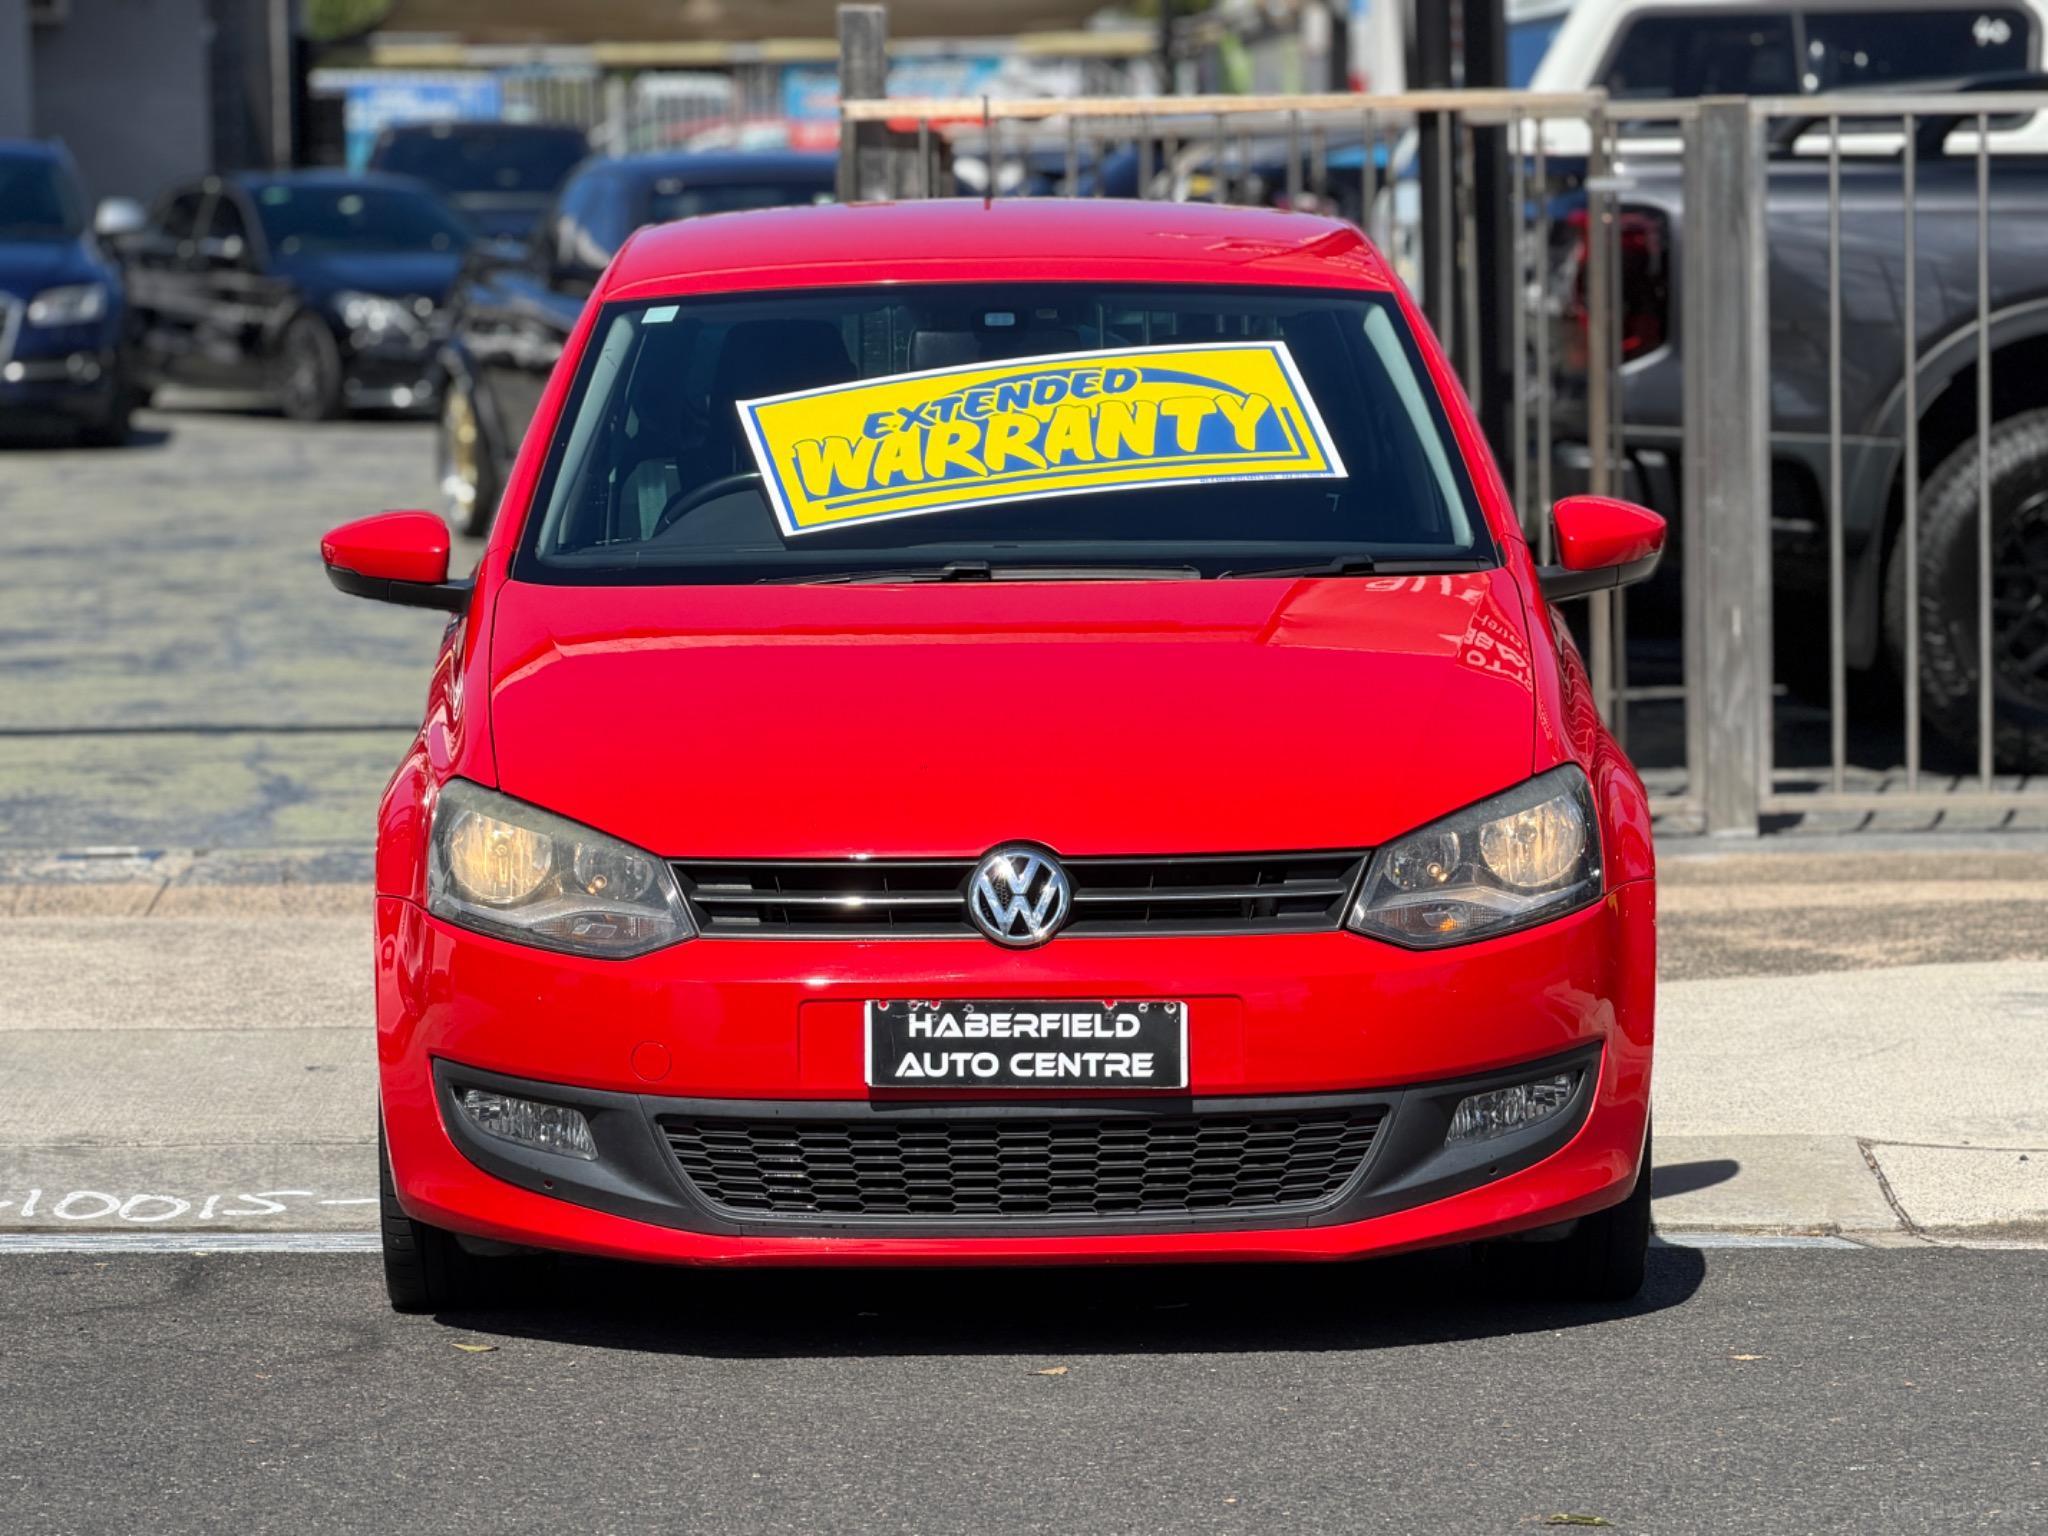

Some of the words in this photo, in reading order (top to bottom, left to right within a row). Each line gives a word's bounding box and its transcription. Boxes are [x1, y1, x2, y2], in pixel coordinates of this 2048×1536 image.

[864, 366, 1142, 440] EXTENDED
[793, 393, 1273, 497] WARRANTY
[978, 851, 1063, 938] VW
[908, 1013, 1141, 1038] HABERFIELD
[895, 1052, 1000, 1078] AUTO
[1010, 1052, 1154, 1078] CENTRE
